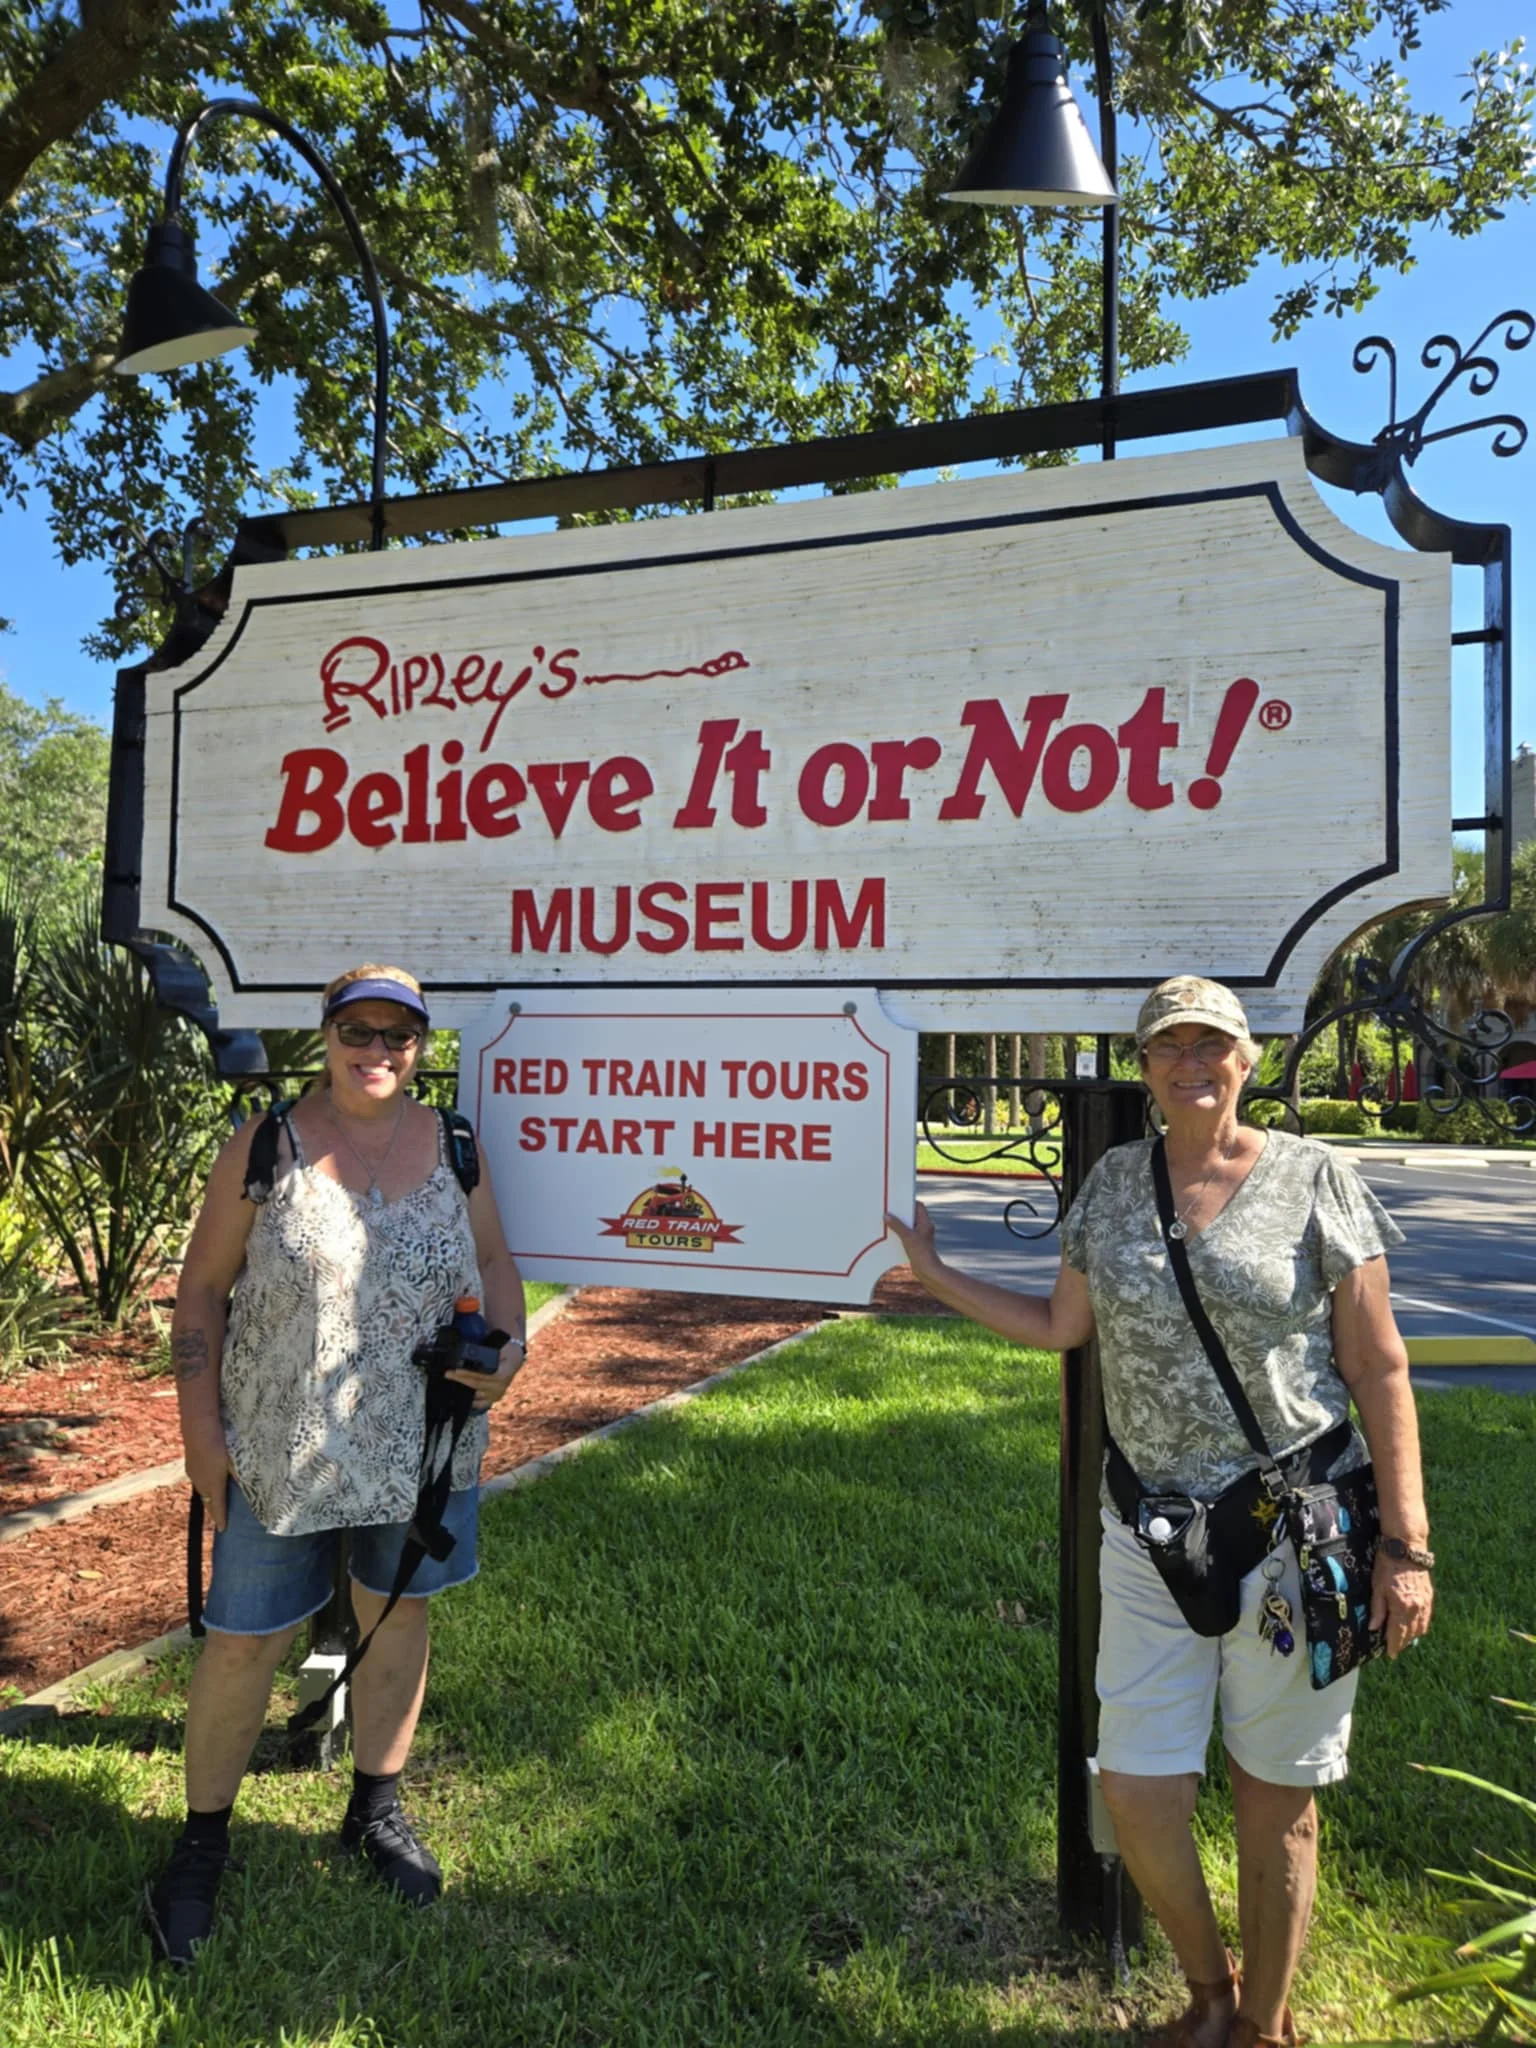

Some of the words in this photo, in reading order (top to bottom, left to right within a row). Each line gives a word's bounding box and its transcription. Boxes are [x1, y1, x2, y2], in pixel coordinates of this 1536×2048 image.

[264, 740, 653, 854] Believe
[674, 719, 771, 829] It
[798, 736, 941, 828] or
[511, 877, 885, 955] MUSEUM
[493, 1058, 569, 1095] RED
[582, 1059, 706, 1098] TRAIN
[721, 1061, 869, 1101] TOURS
[519, 1116, 675, 1156] START
[693, 1121, 833, 1162] HERE
[622, 1218, 660, 1230] RED
[667, 1220, 720, 1233] TRAIN
[636, 1233, 703, 1248] TOURS
